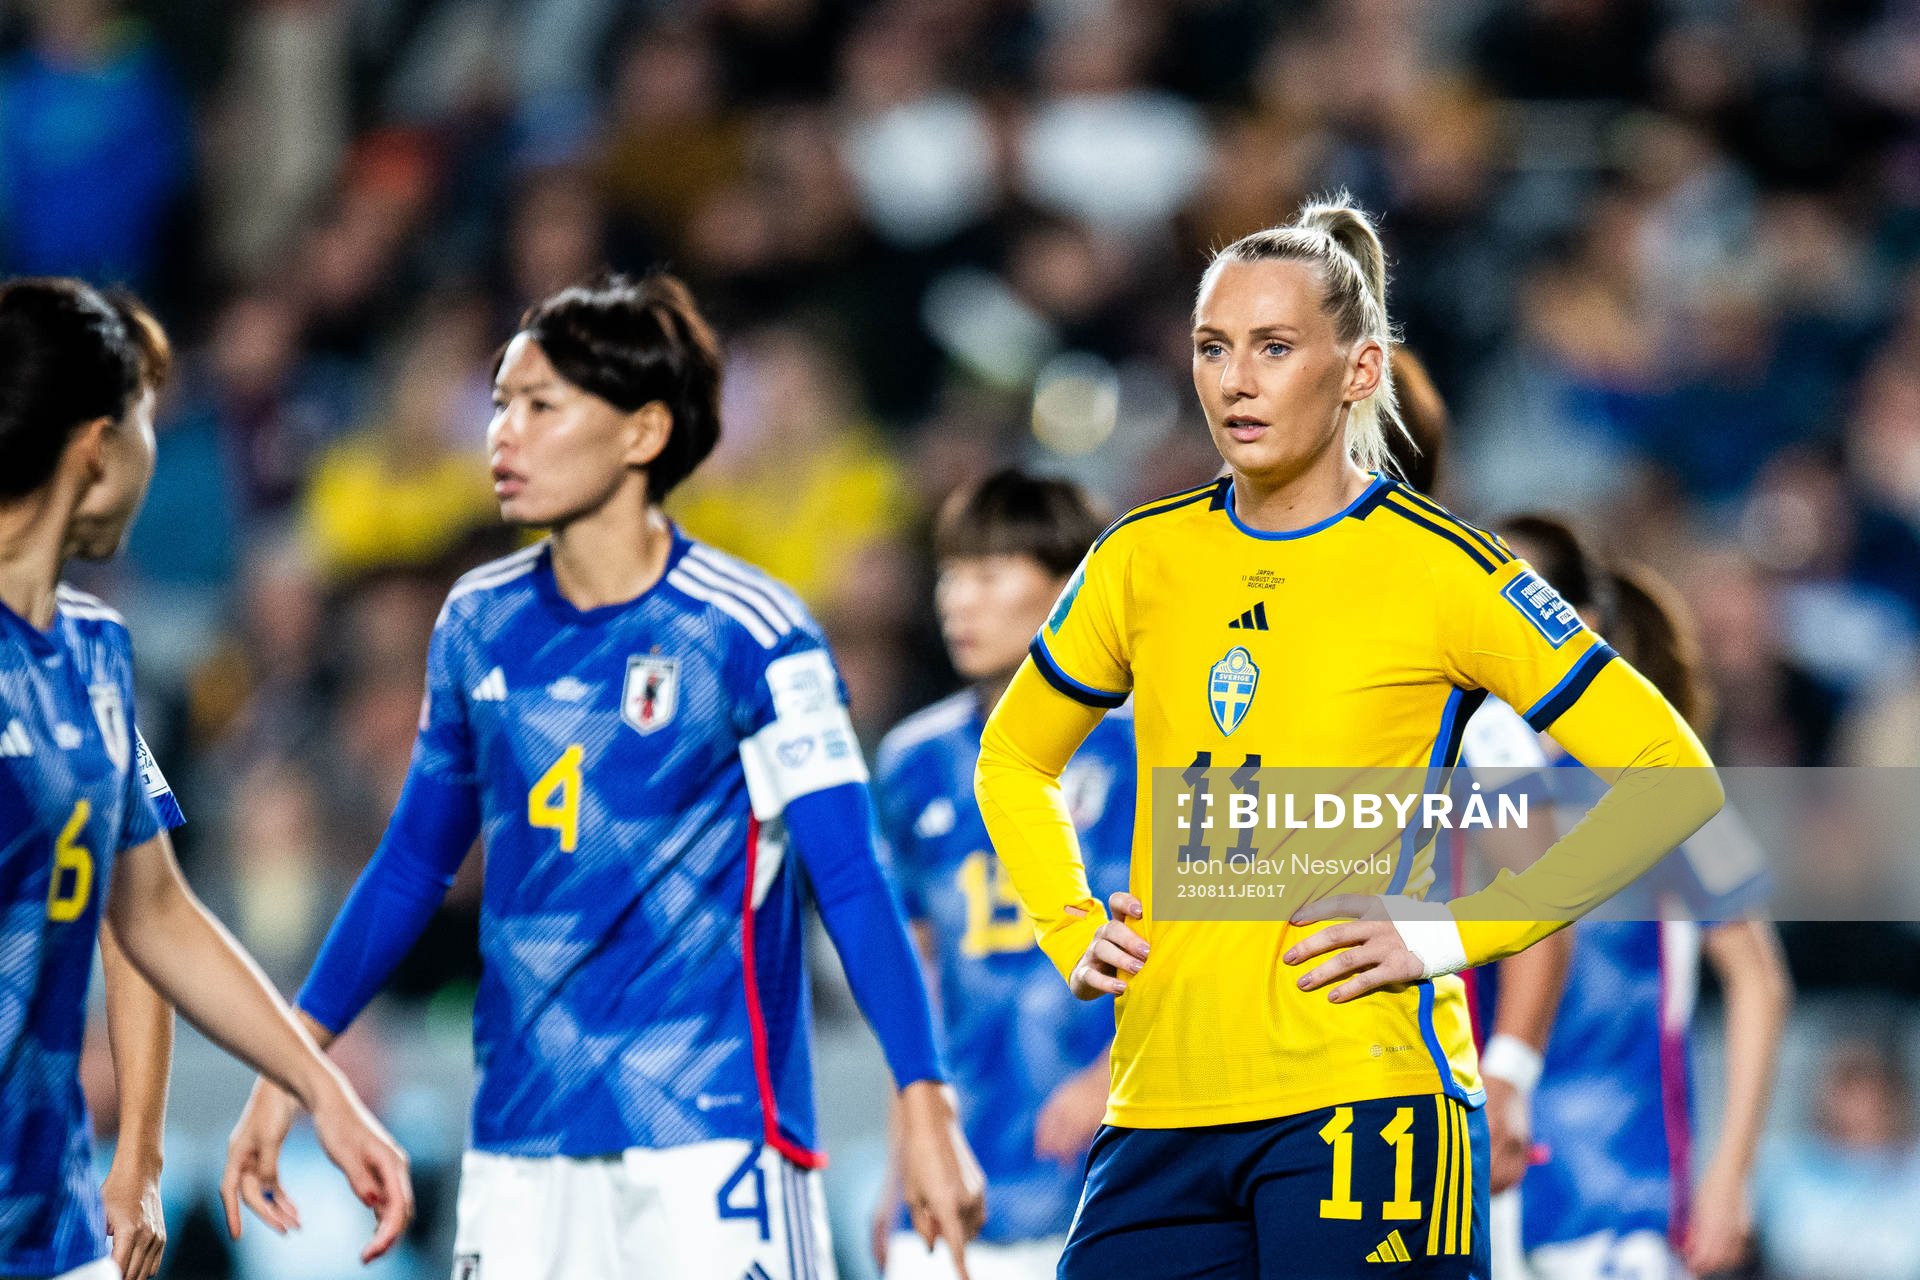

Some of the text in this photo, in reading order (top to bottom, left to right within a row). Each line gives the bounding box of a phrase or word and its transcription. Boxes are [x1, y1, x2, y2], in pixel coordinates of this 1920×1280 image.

[1247, 582, 1276, 590] AUCKLAND
[1218, 673, 1251, 682] SVERIGE
[528, 743, 584, 853] 4
[1177, 751, 1262, 864] 11
[47, 799, 94, 922] 6
[717, 1142, 771, 1241] 4
[1318, 1107, 1422, 1221] 11
